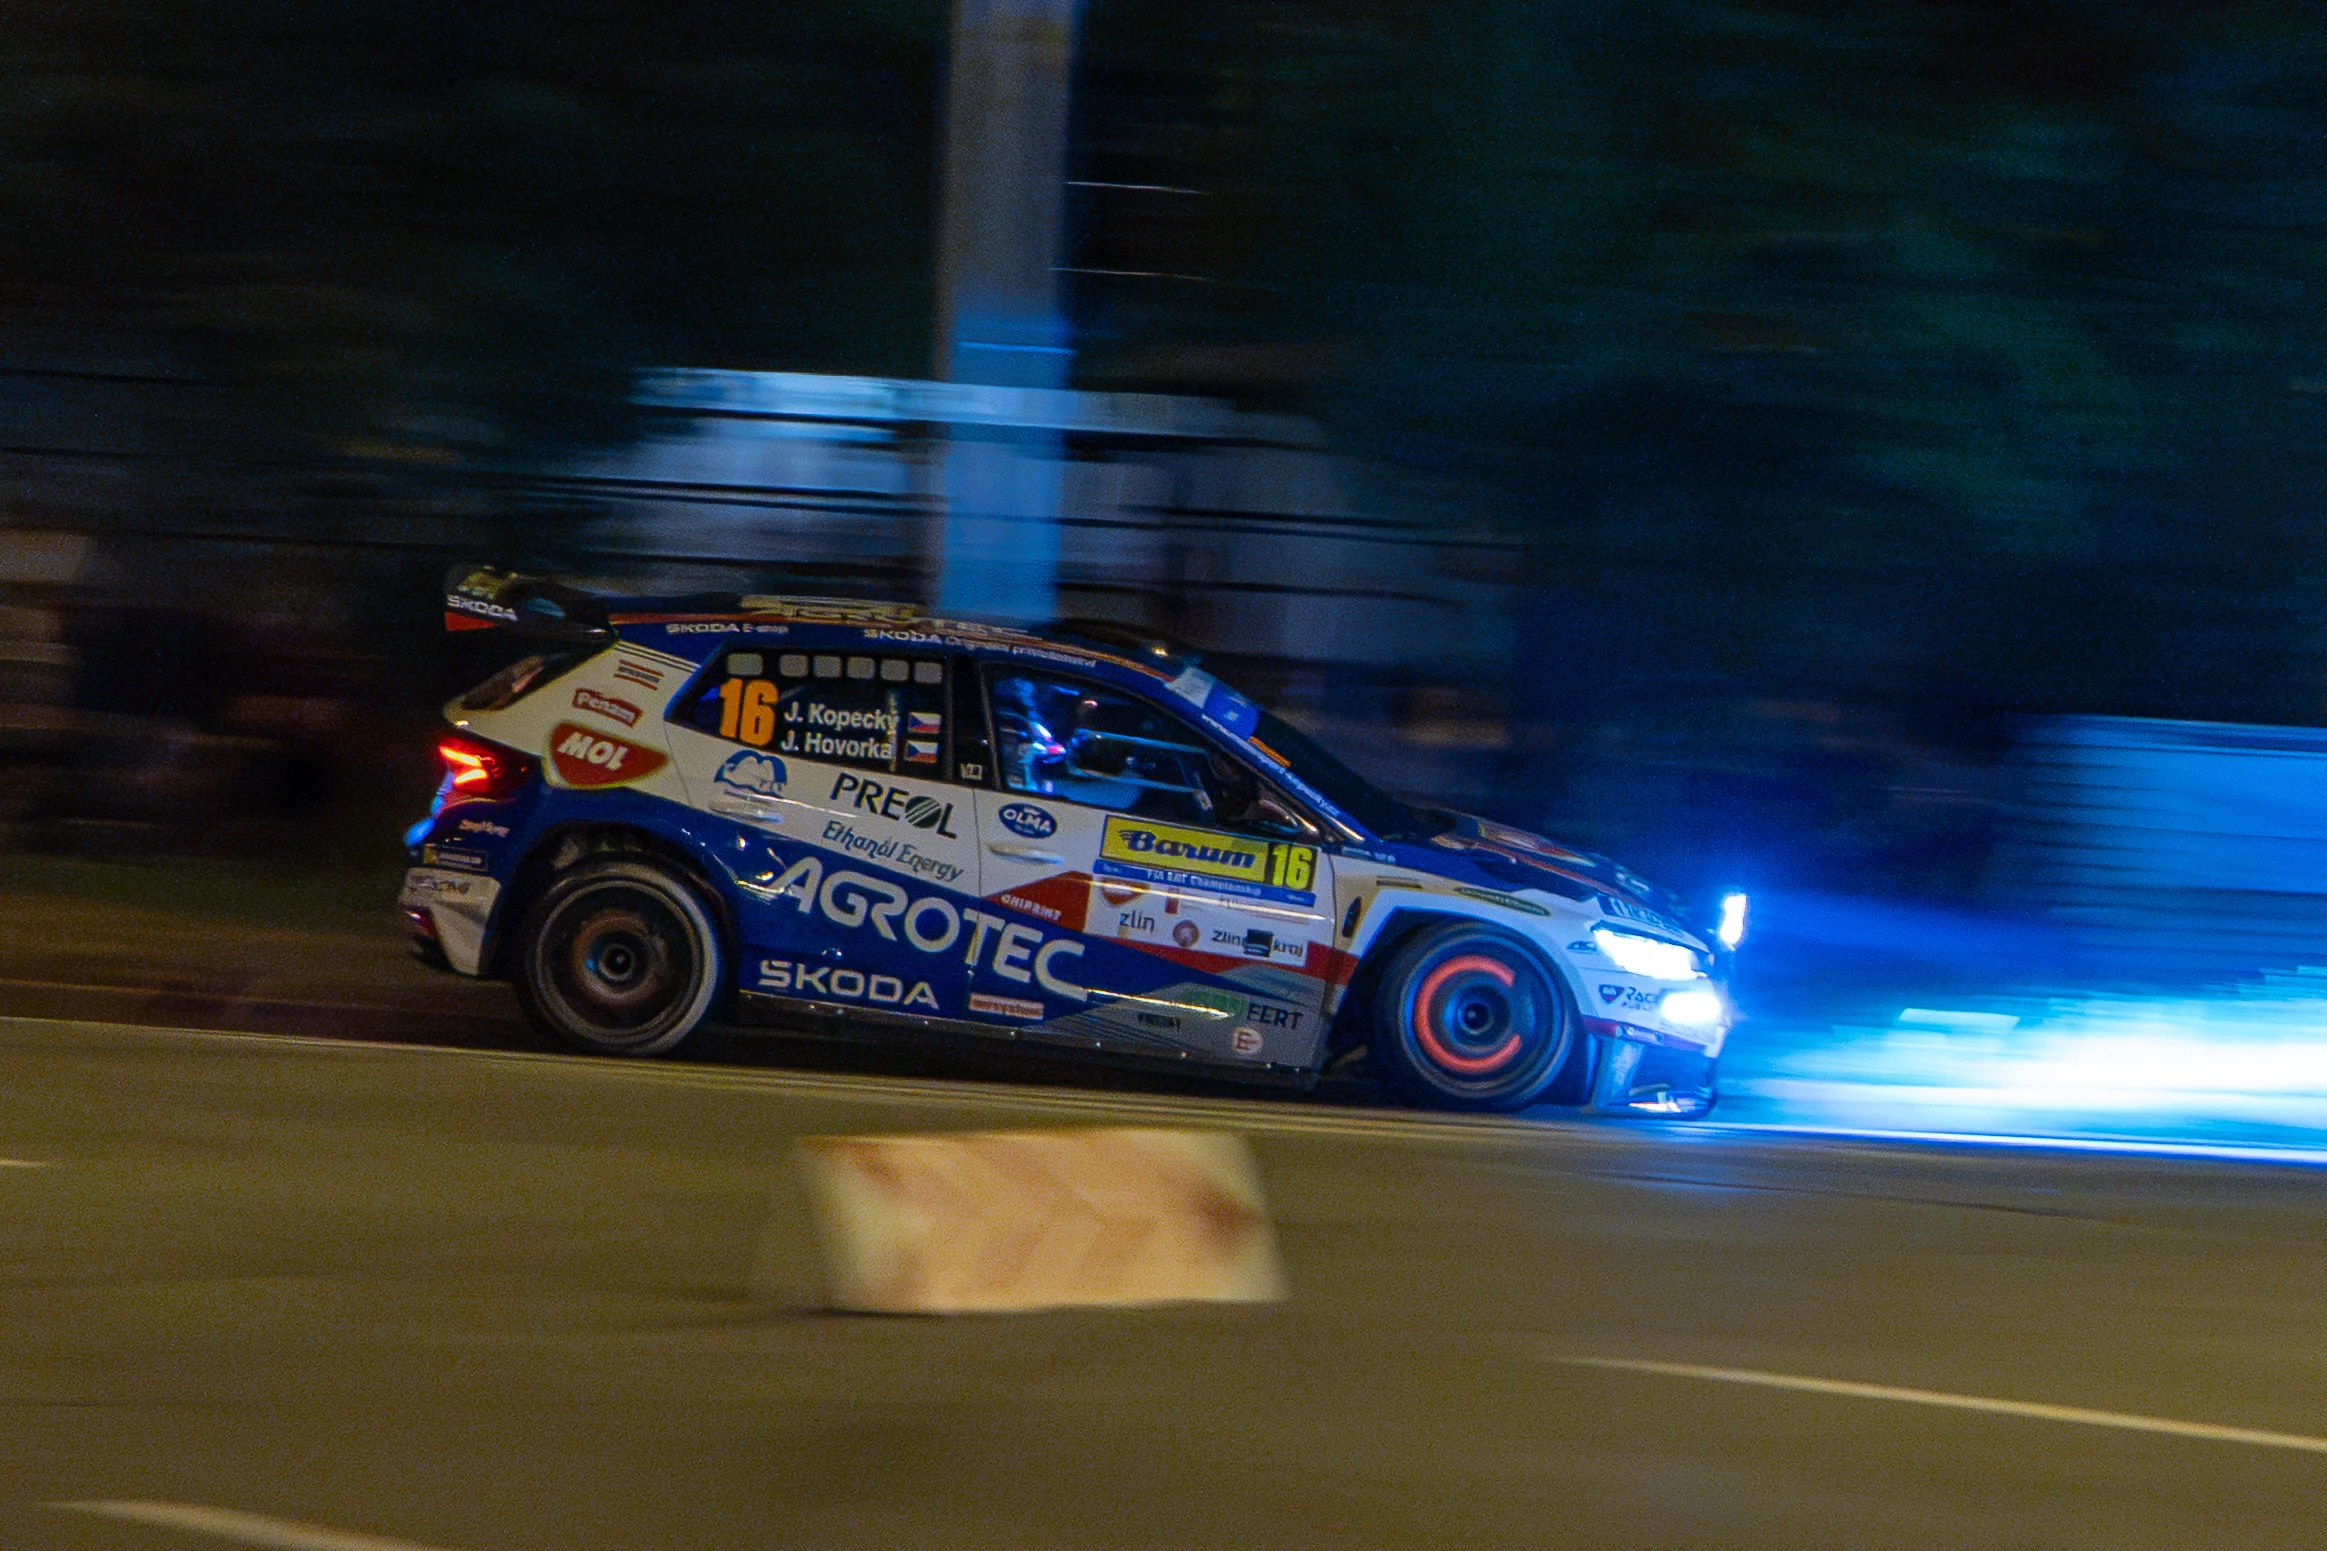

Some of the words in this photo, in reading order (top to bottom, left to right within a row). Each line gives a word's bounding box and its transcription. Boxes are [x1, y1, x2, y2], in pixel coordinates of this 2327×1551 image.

[719, 678, 779, 746] 16
[784, 701, 804, 723] J.
[556, 731, 629, 771] MOL
[781, 730, 800, 752] J.
[805, 732, 893, 759] Hovorka
[830, 772, 957, 839] PREOL
[1003, 808, 1051, 833] OLMA
[895, 842, 965, 882] Energy
[1118, 829, 1256, 869] Barum
[1271, 844, 1313, 890] 16
[768, 855, 1088, 1003] AGROTEC
